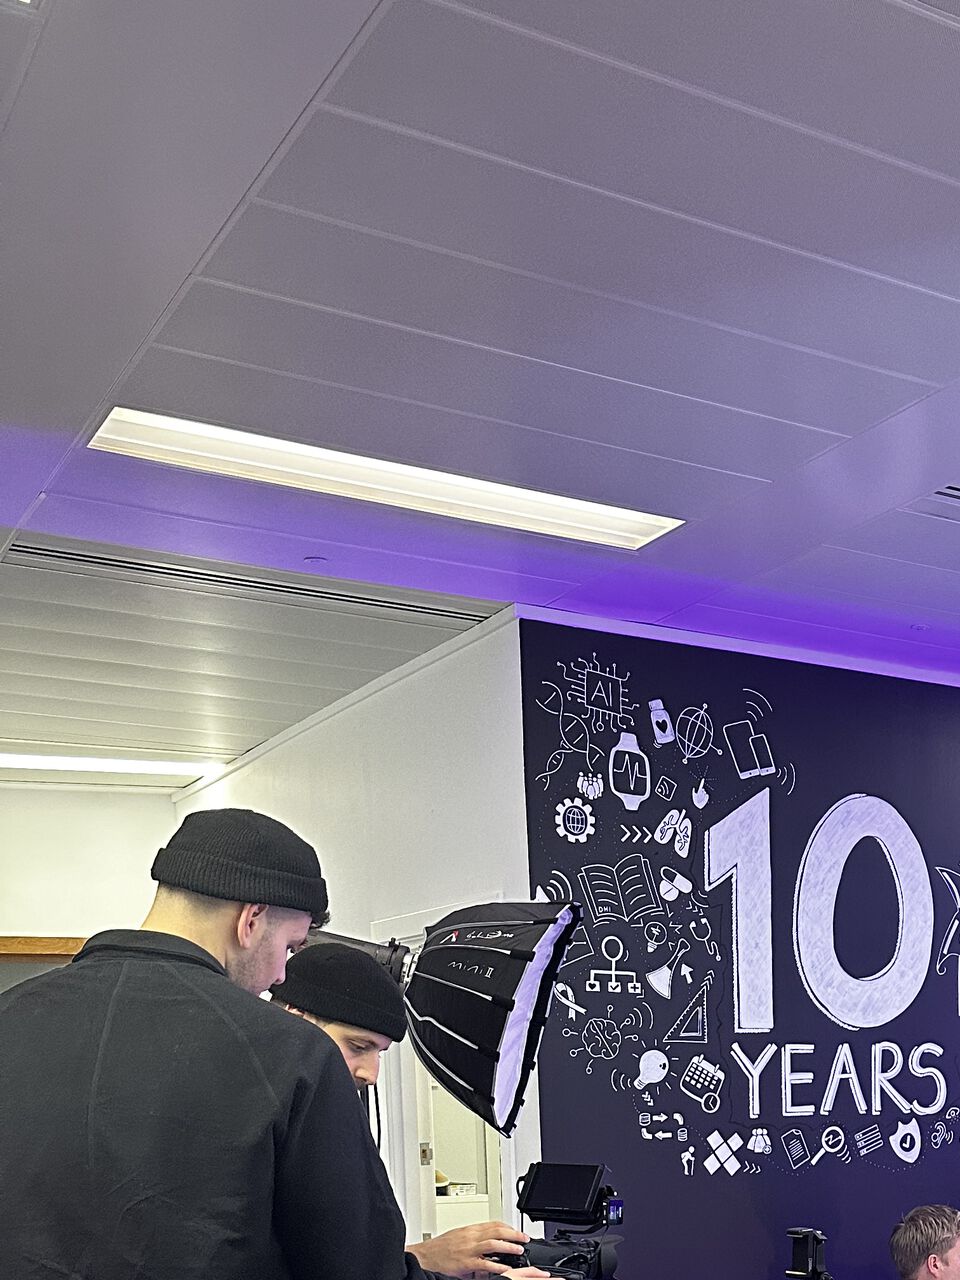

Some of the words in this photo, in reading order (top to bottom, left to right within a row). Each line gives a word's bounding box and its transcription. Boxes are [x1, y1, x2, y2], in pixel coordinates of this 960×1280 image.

[591, 681, 613, 707] AI
[704, 787, 935, 1033] 10
[731, 1042, 948, 1119] YEARS
